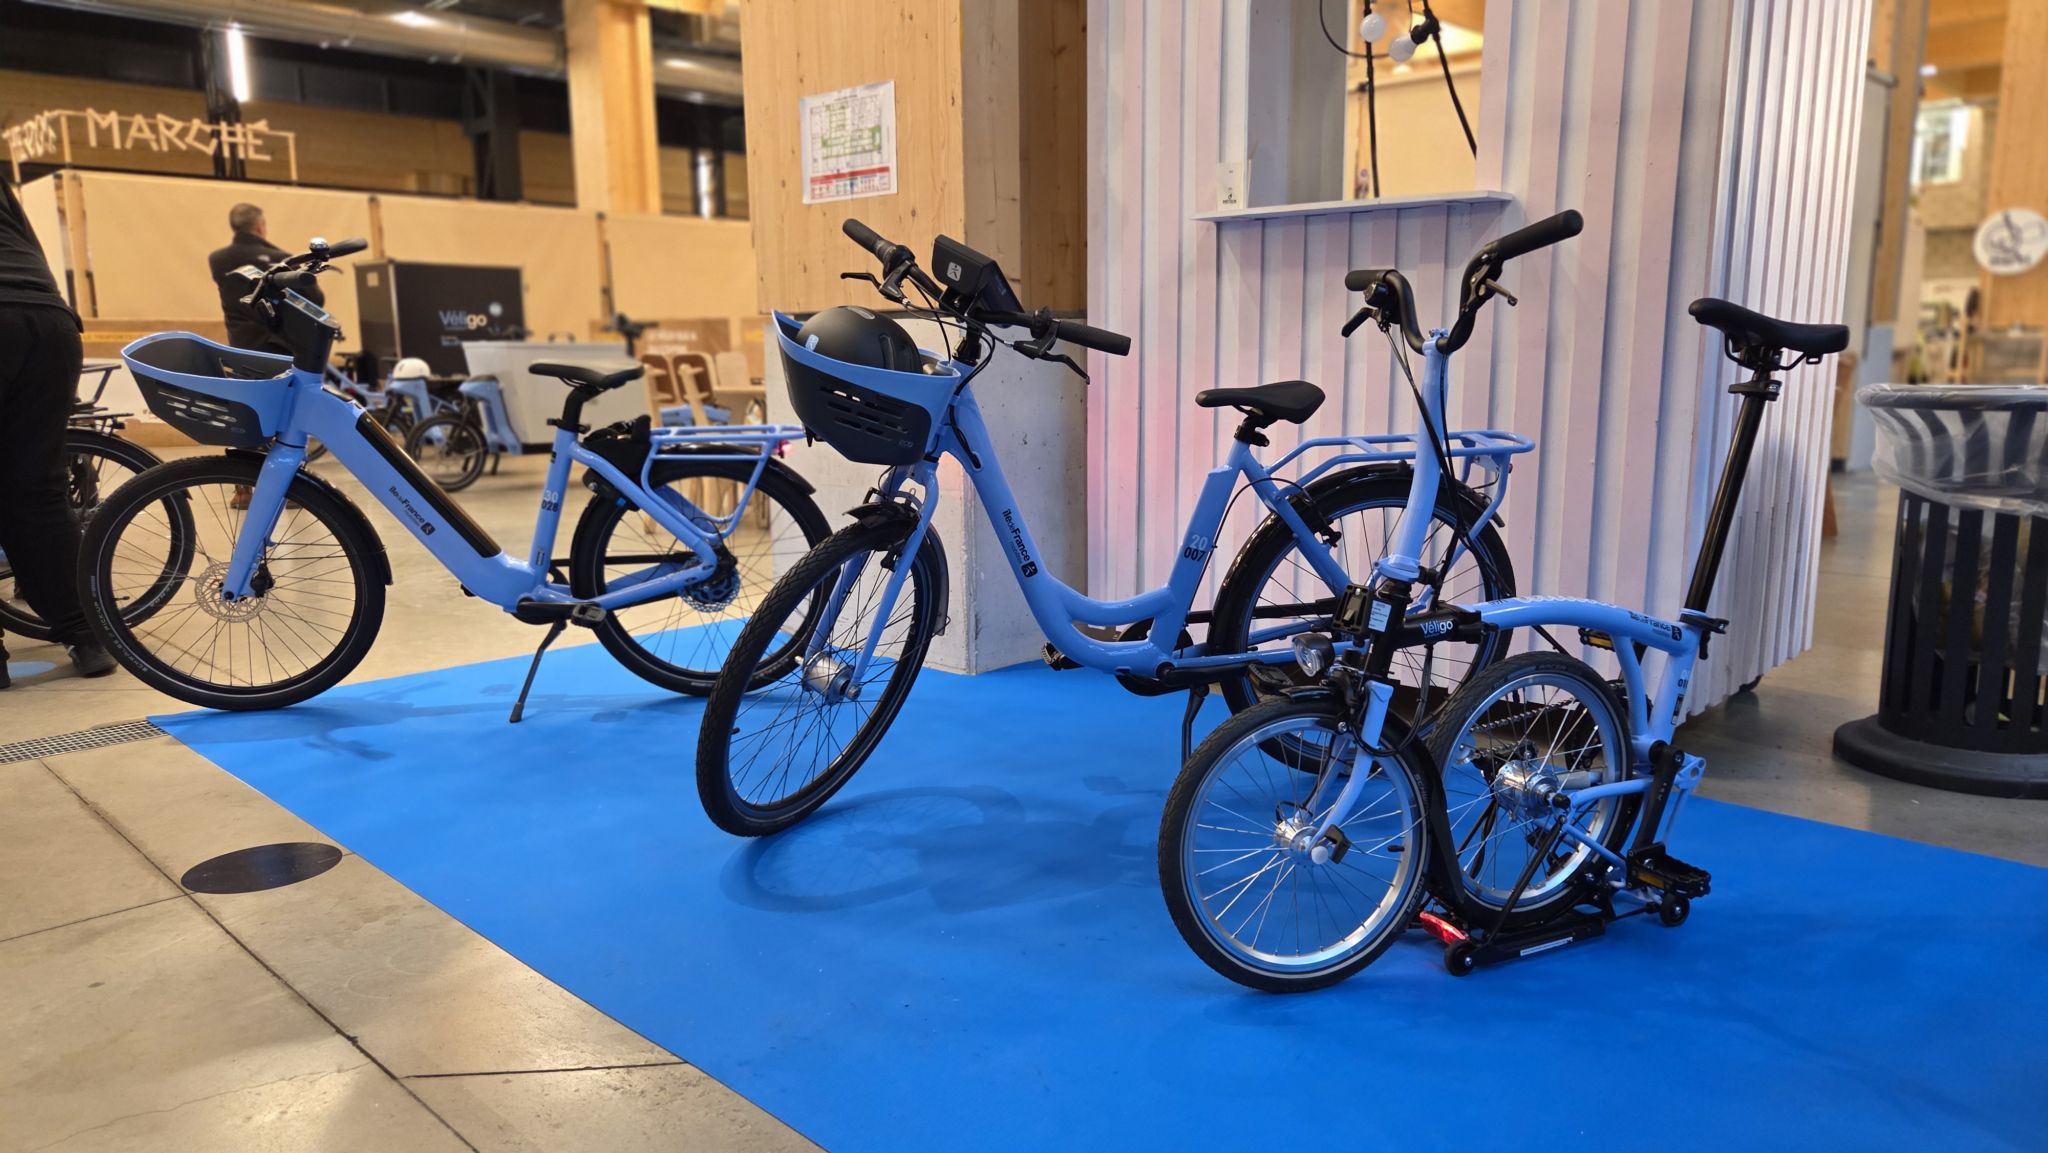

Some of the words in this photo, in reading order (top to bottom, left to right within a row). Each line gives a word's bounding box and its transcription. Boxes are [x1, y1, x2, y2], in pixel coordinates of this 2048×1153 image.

[85, 107, 271, 161] MARCHÉ
[438, 309, 488, 331] Véligo
[544, 490, 559, 503] 30
[1190, 534, 1208, 550] 20
[1183, 546, 1206, 562] 007
[1420, 620, 1454, 635] Véligo
